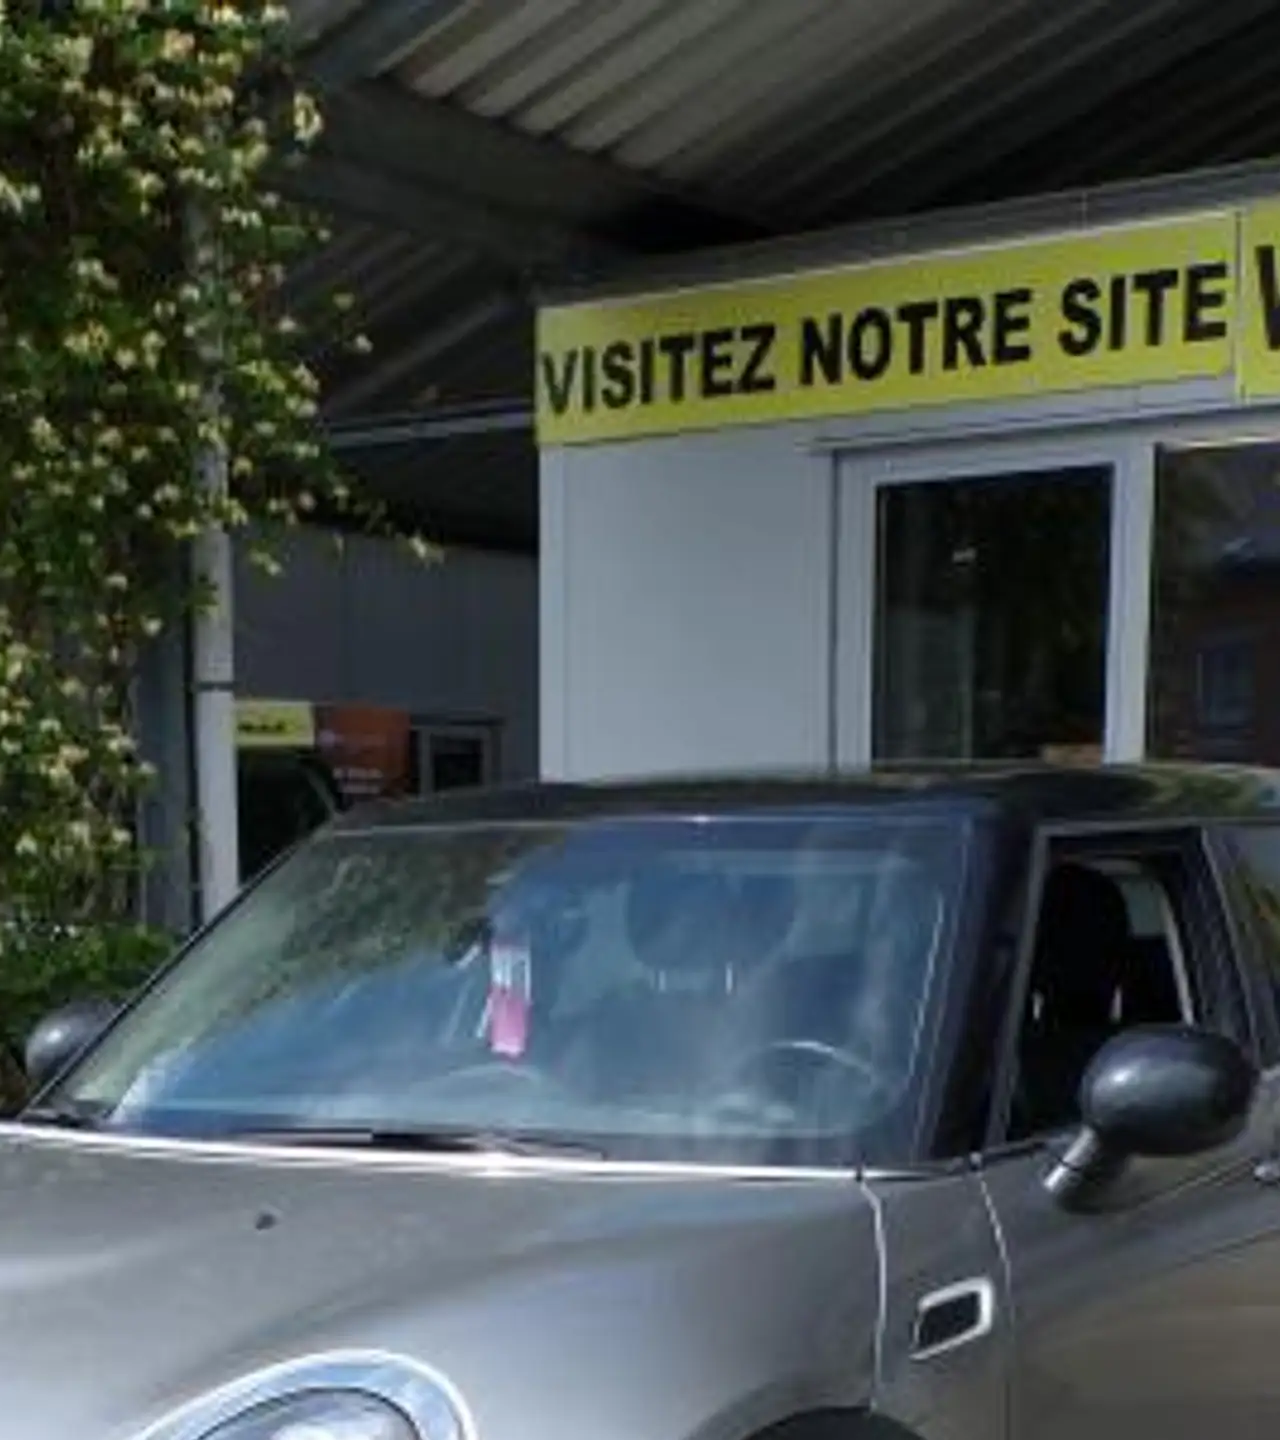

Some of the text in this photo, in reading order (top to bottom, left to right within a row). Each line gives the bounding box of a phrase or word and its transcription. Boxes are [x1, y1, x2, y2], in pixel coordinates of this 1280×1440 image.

[540, 255, 1228, 415] VISITEZ NOTRE SITE
